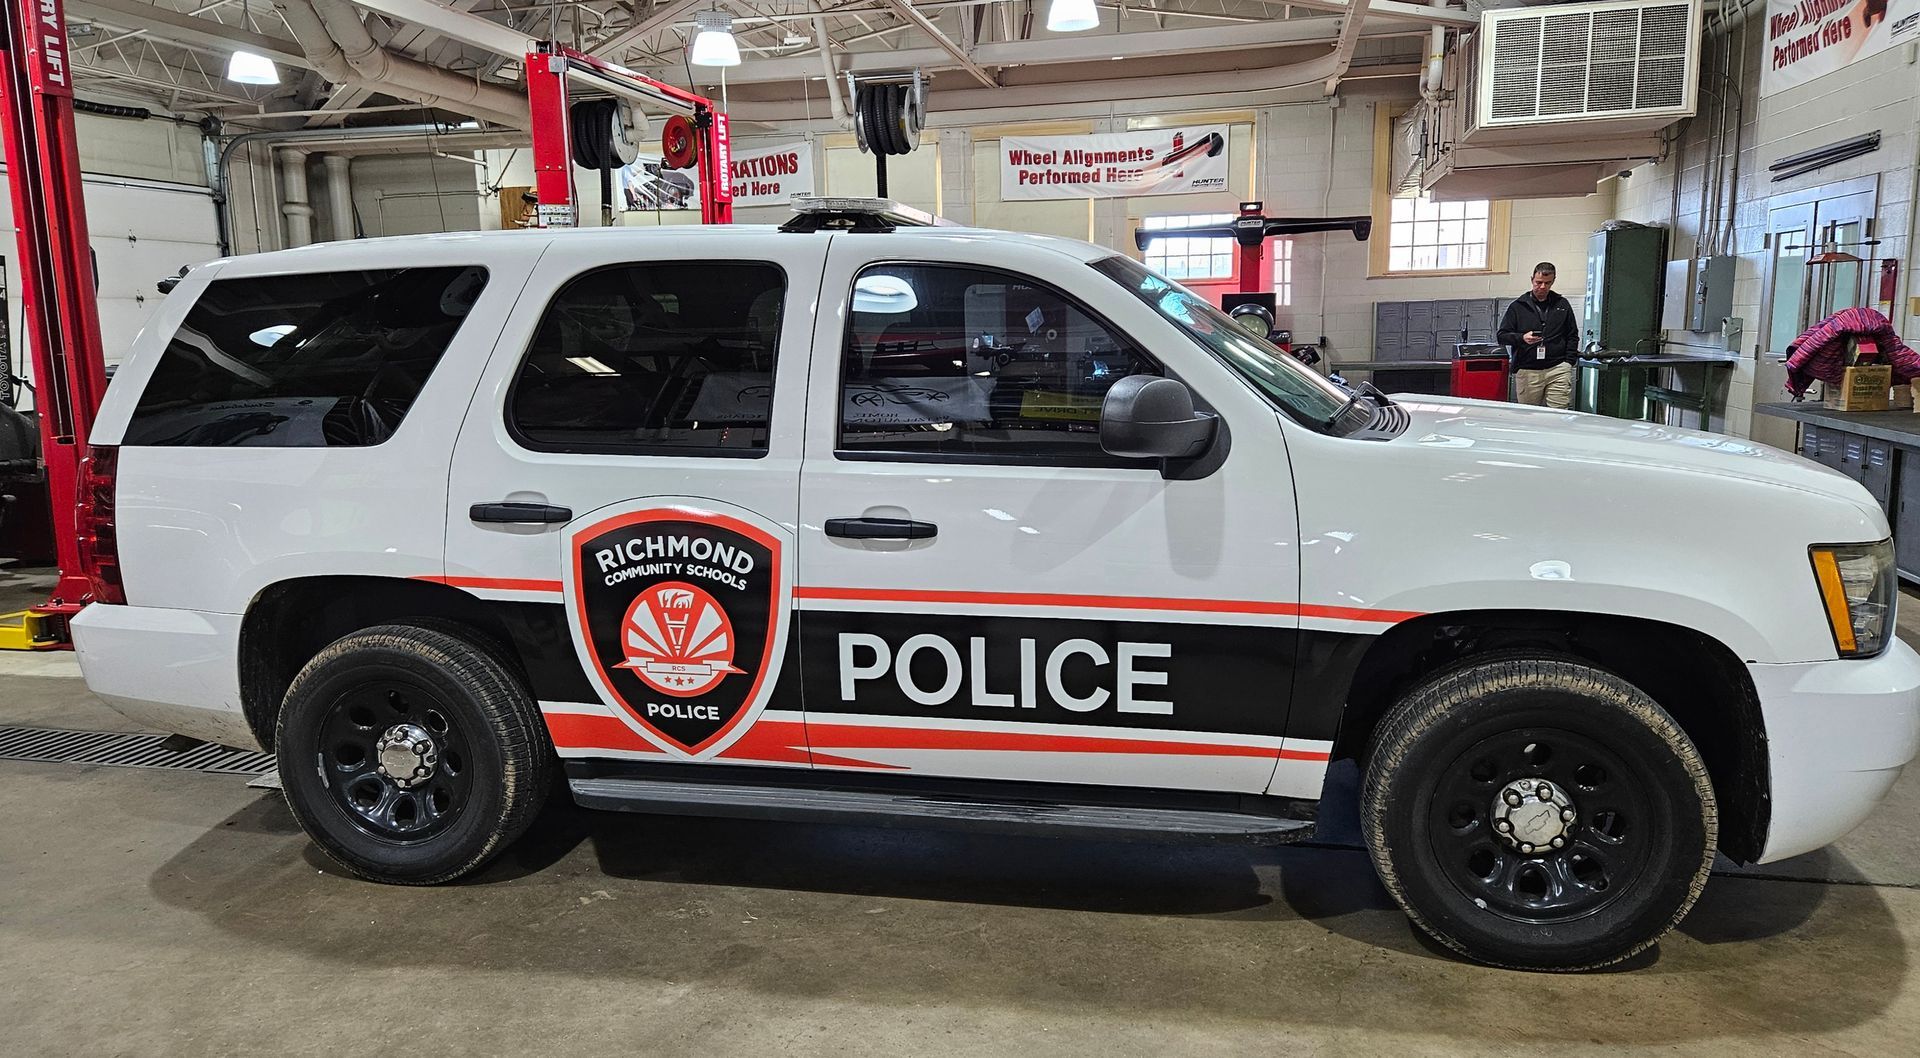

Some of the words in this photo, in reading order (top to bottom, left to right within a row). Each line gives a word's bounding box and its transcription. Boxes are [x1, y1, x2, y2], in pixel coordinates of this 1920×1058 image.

[1770, 5, 1800, 41] Wheel
[1773, 24, 1822, 71] Performed
[1823, 16, 1852, 48] Here
[44, 35, 65, 87] LIFT
[717, 113, 727, 141] LIFT
[718, 141, 730, 192] ROTARY
[731, 152, 798, 178] RATIONS
[1009, 150, 1057, 165] Wheel
[1063, 147, 1154, 167] Alignments
[751, 181, 780, 196] Here
[1020, 168, 1100, 185] Performed
[1106, 167, 1144, 182] Here
[595, 536, 754, 573] RICHMOND
[604, 563, 683, 586] COMMUNITY
[686, 563, 748, 591] SCHOOLS
[838, 632, 1174, 715] POLICE
[646, 702, 720, 721] POLICE
